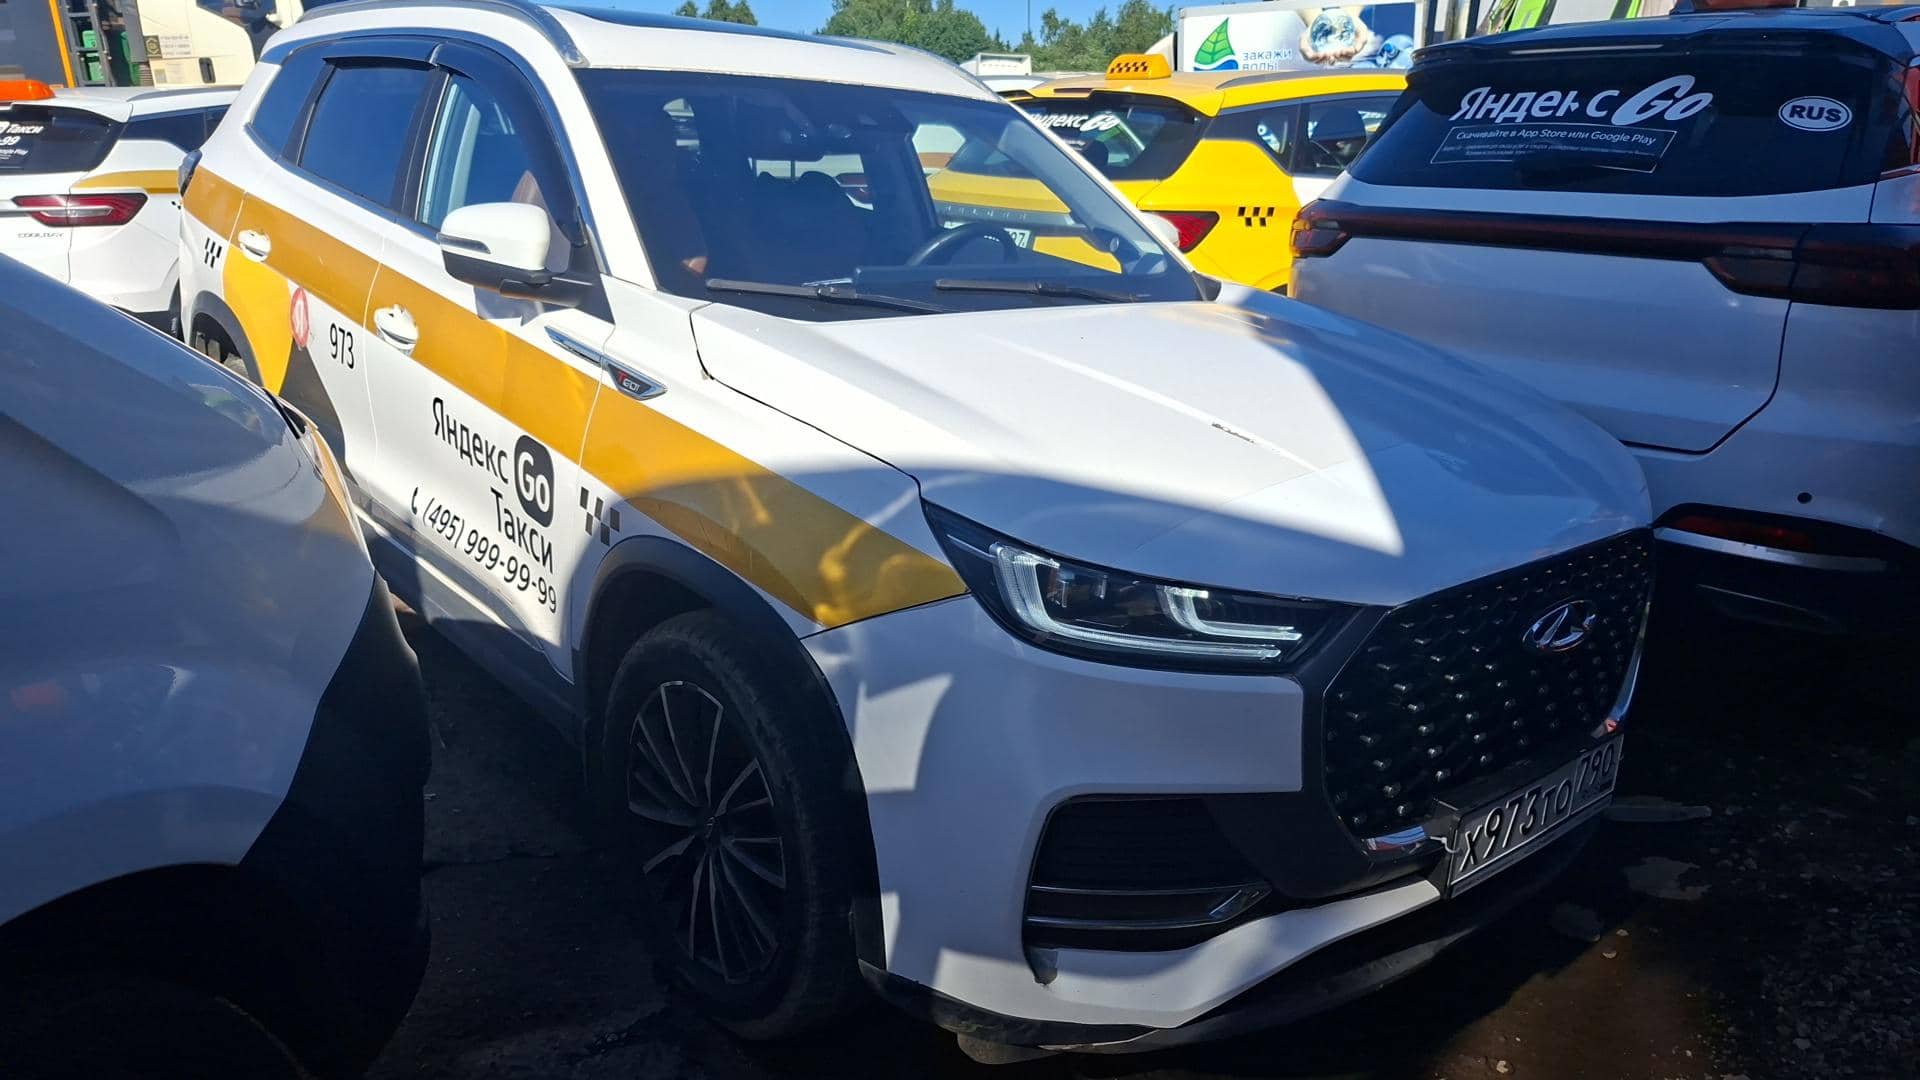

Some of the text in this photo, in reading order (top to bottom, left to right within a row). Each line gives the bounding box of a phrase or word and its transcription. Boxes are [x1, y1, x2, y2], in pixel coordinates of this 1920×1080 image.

[1242, 49, 1292, 61] закажи
[1610, 74, 1714, 126] Go
[1788, 104, 1842, 123] RUS
[1517, 129, 1539, 139] App
[1539, 128, 1568, 139] Store
[1567, 131, 1589, 139] или
[1590, 130, 1631, 144] Google
[1631, 133, 1657, 146] Play
[329, 322, 354, 370] 973
[432, 396, 551, 513] Яндекс Go
[490, 486, 554, 574] Такси
[422, 497, 557, 614] (495) 999-99-99
